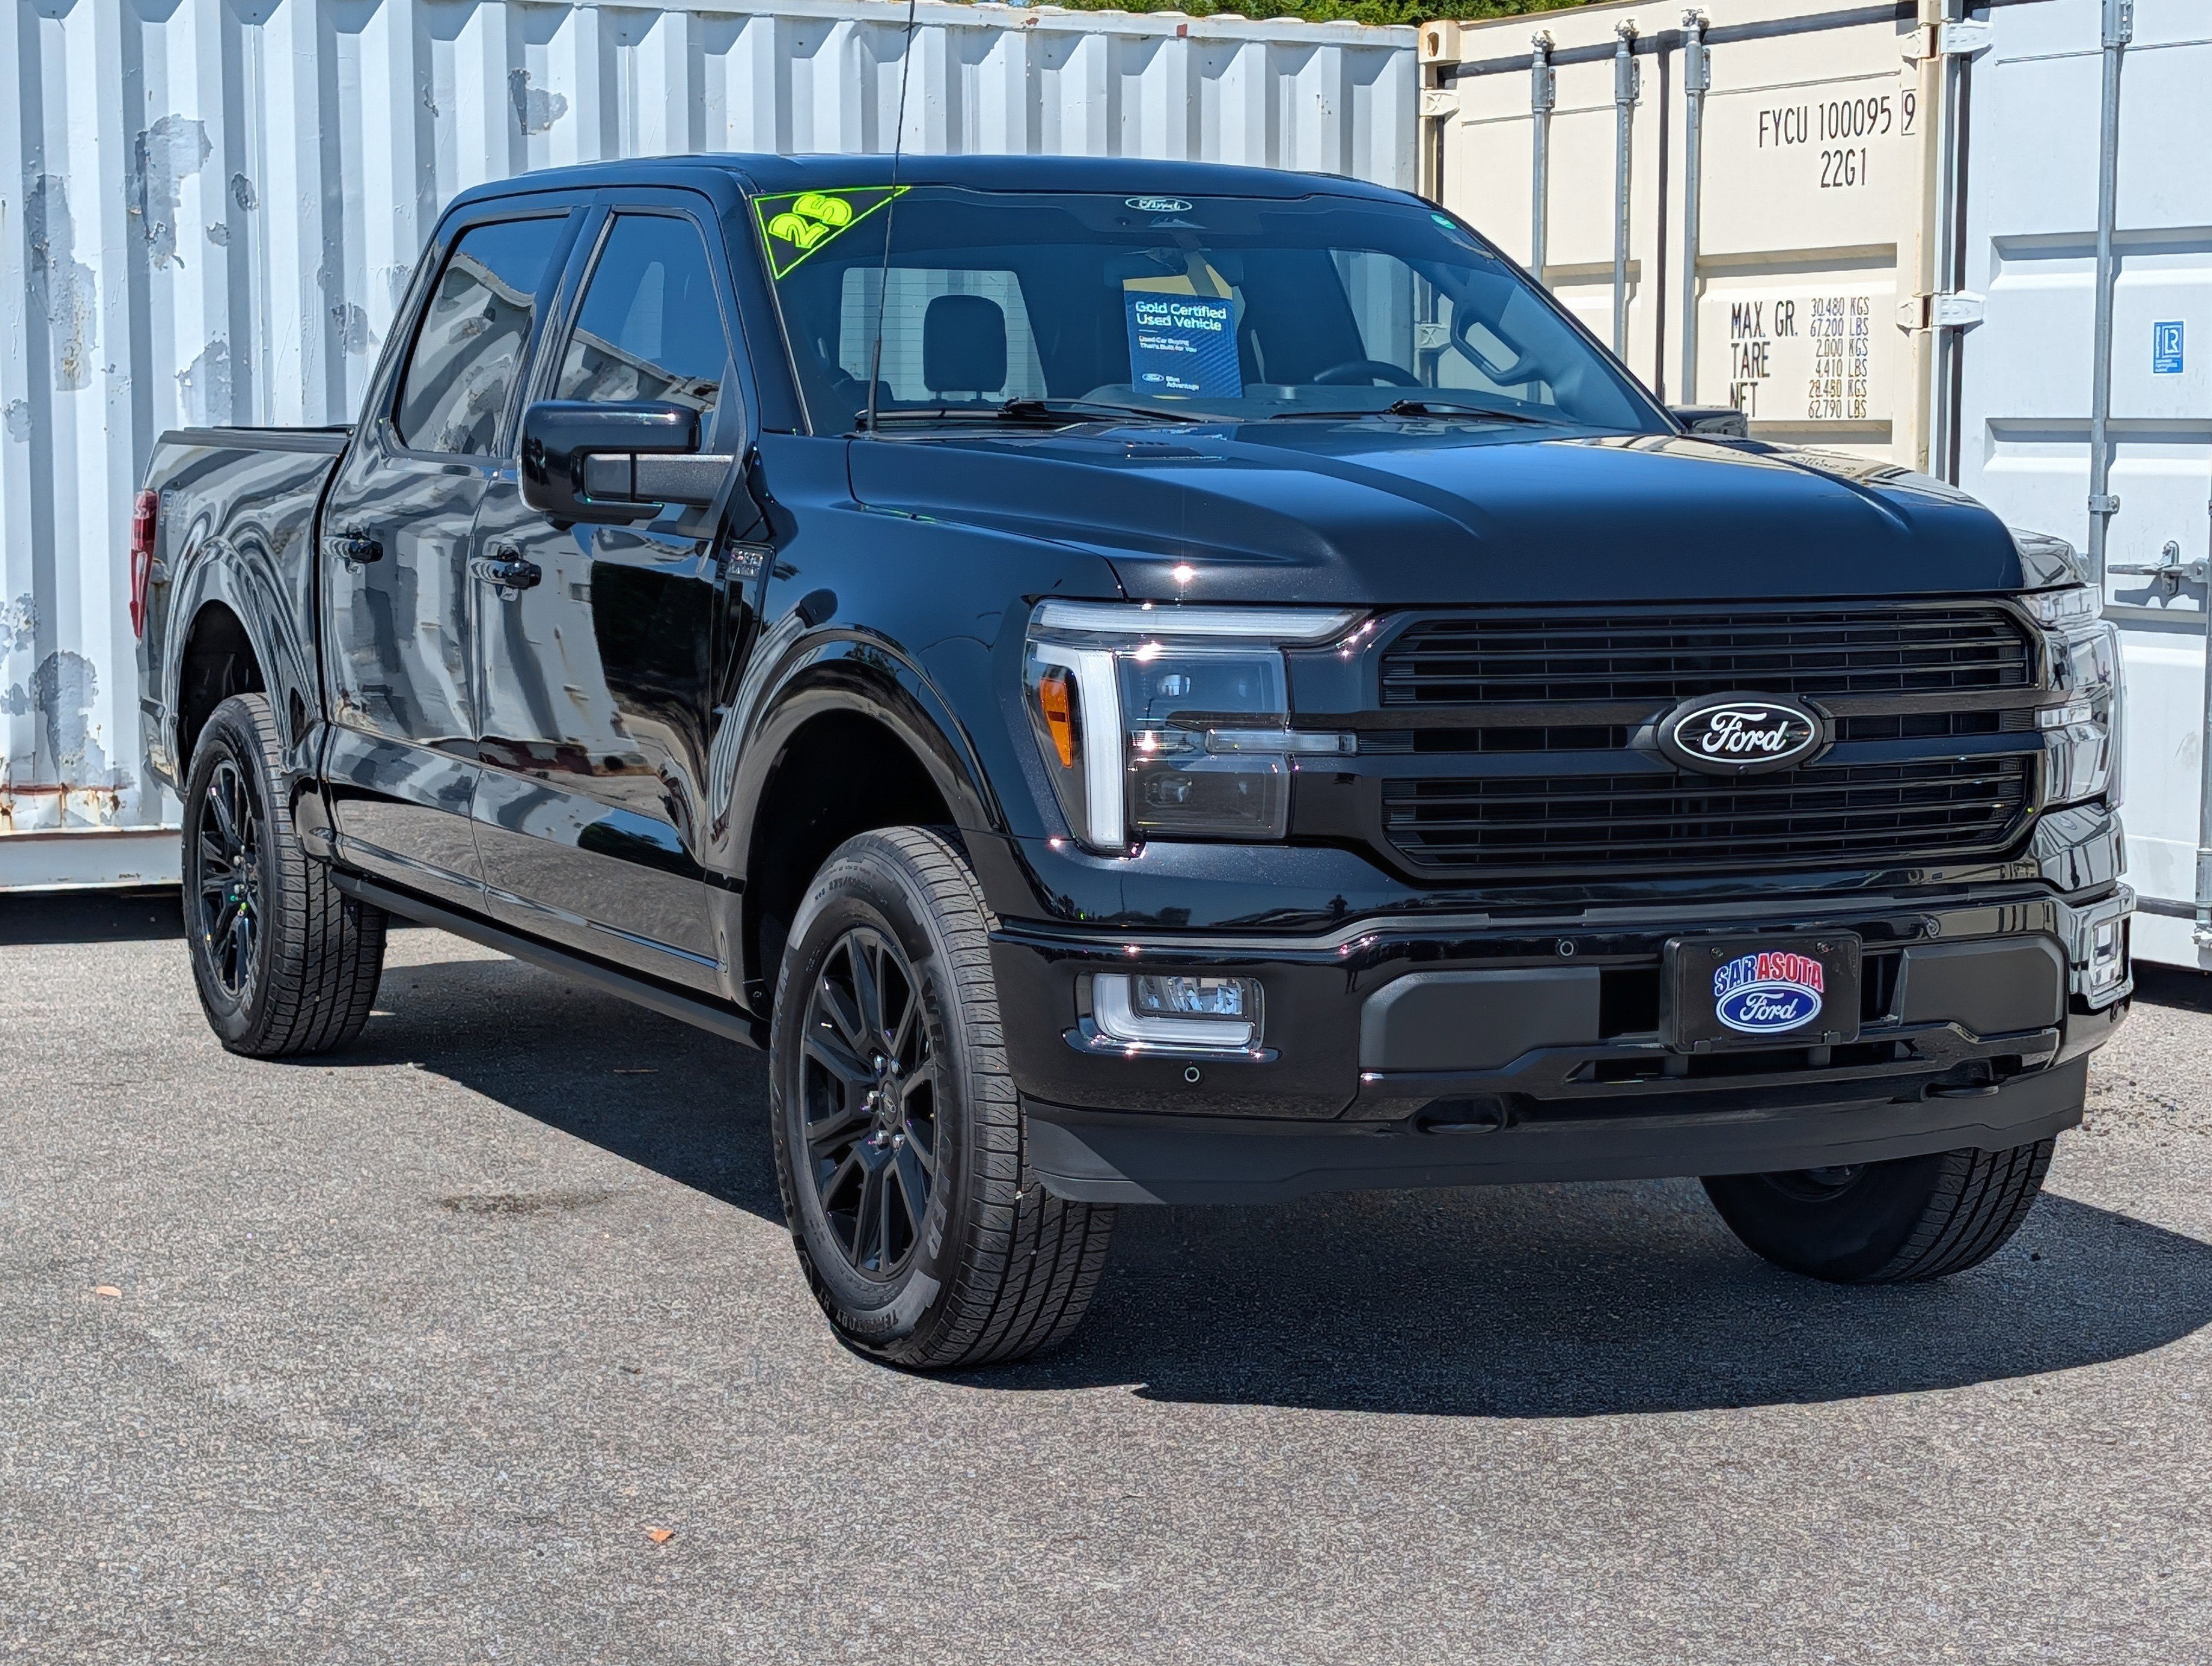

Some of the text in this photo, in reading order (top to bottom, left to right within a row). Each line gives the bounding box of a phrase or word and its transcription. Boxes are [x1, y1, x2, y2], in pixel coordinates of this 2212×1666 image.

[1759, 92, 1916, 148] FYCU 100095 9
[1820, 147, 1867, 188] 22G1
[768, 194, 852, 249] 25
[1135, 301, 1227, 319] Gold Certified
[1850, 296, 1870, 316] KGS
[1136, 312, 1222, 331] Used Vehicle
[1849, 317, 1869, 336] LBS
[1848, 337, 1869, 357] KGS
[1731, 341, 1771, 379] TARE
[1848, 358, 1867, 377] LBS
[1729, 381, 1758, 418] NET
[1847, 379, 1867, 398] KGS
[1847, 399, 1867, 419] LBS
[1702, 711, 1789, 753] Ford
[1714, 952, 1824, 997] SARASOTA
[1739, 992, 1798, 1021] Ford
